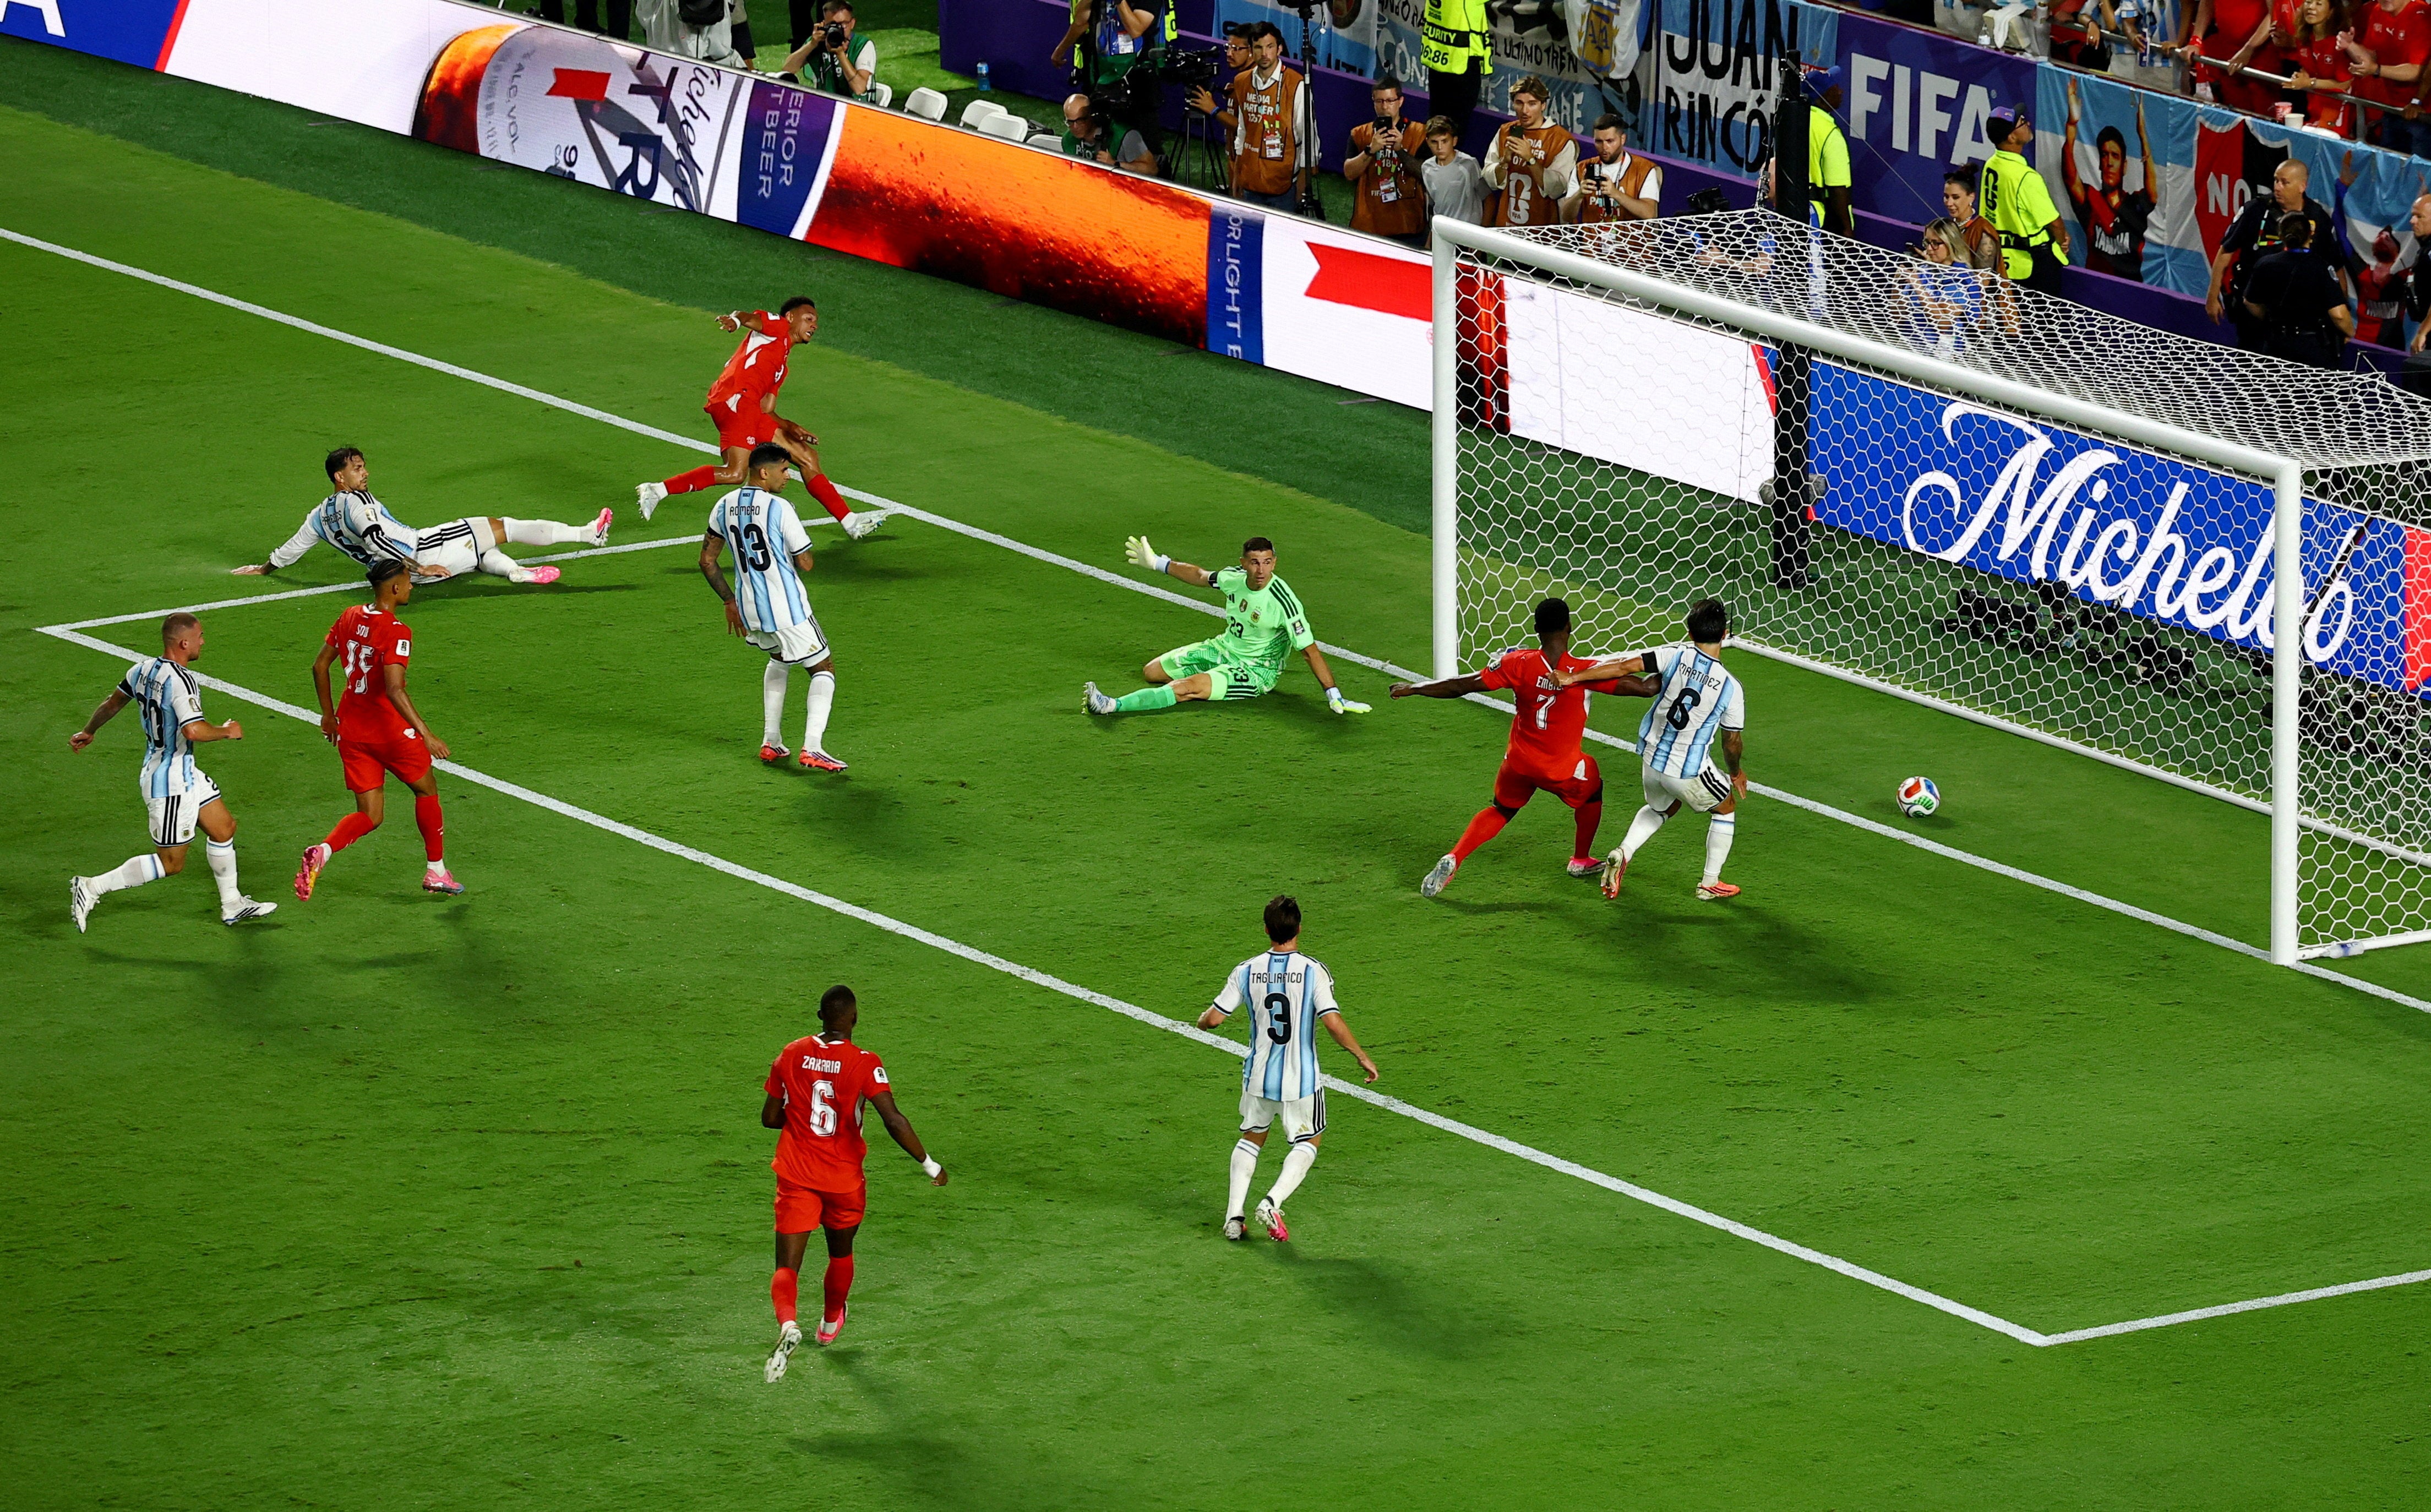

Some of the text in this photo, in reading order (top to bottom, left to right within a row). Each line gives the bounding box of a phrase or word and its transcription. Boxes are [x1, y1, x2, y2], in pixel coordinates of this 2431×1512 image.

[1244, 102, 1274, 116] PARTER
[1246, 92, 1270, 105] MEDIA
[1849, 52, 1995, 166] FIFA
[729, 505, 760, 516] ROMERO
[729, 523, 771, 574] 13
[1229, 616, 1244, 639] 23
[1536, 694, 1556, 730] 7
[1666, 687, 1700, 730] 6
[1251, 972, 1302, 984] TAGLIAFICO
[1264, 992, 1291, 1045] 3
[802, 1056, 841, 1074] ZAKARIA
[810, 1079, 837, 1137] 6
